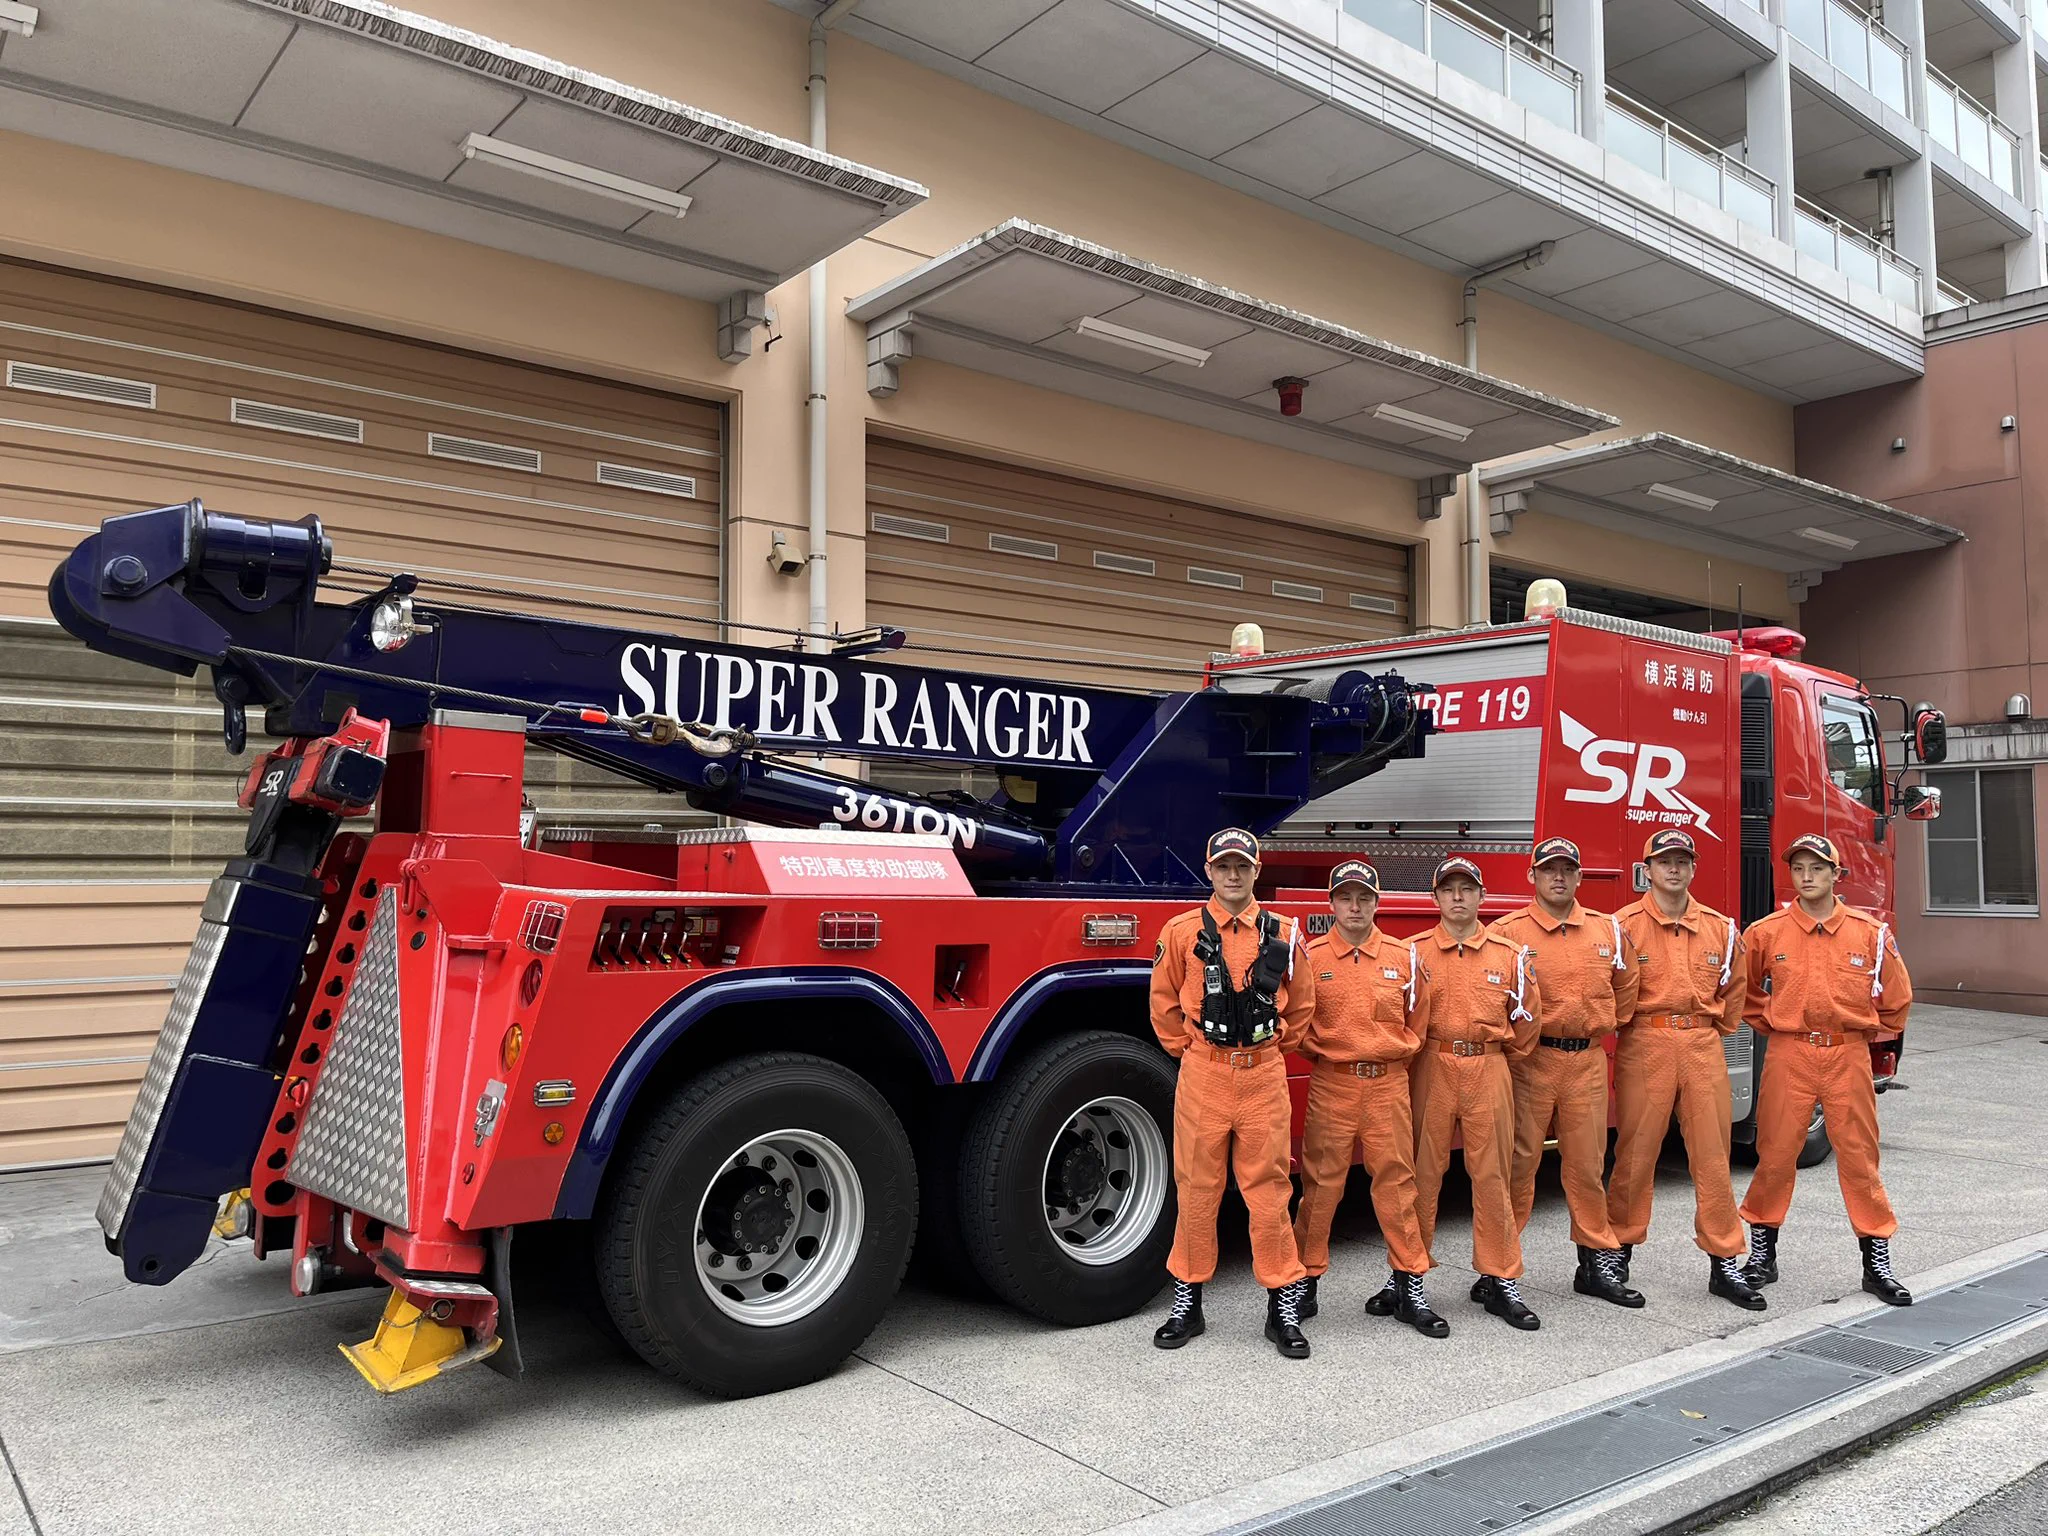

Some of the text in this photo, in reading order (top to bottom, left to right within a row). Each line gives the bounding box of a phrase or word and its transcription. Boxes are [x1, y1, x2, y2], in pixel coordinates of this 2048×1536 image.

[1644, 659, 1713, 694] 横浜消防
[618, 642, 1093, 763] SUPER RANGER
[1406, 685, 1531, 726] IRE 119
[1672, 707, 1708, 725] 機動けん引
[260, 770, 284, 792] SR
[1564, 738, 1688, 811] SR
[832, 785, 977, 849] 36TON
[1625, 808, 1694, 828] super ranger
[1214, 831, 1252, 848] YOKOHAMA
[779, 855, 949, 880] 特別高度救助部隊
[1335, 863, 1372, 880] YOKOHAMA
